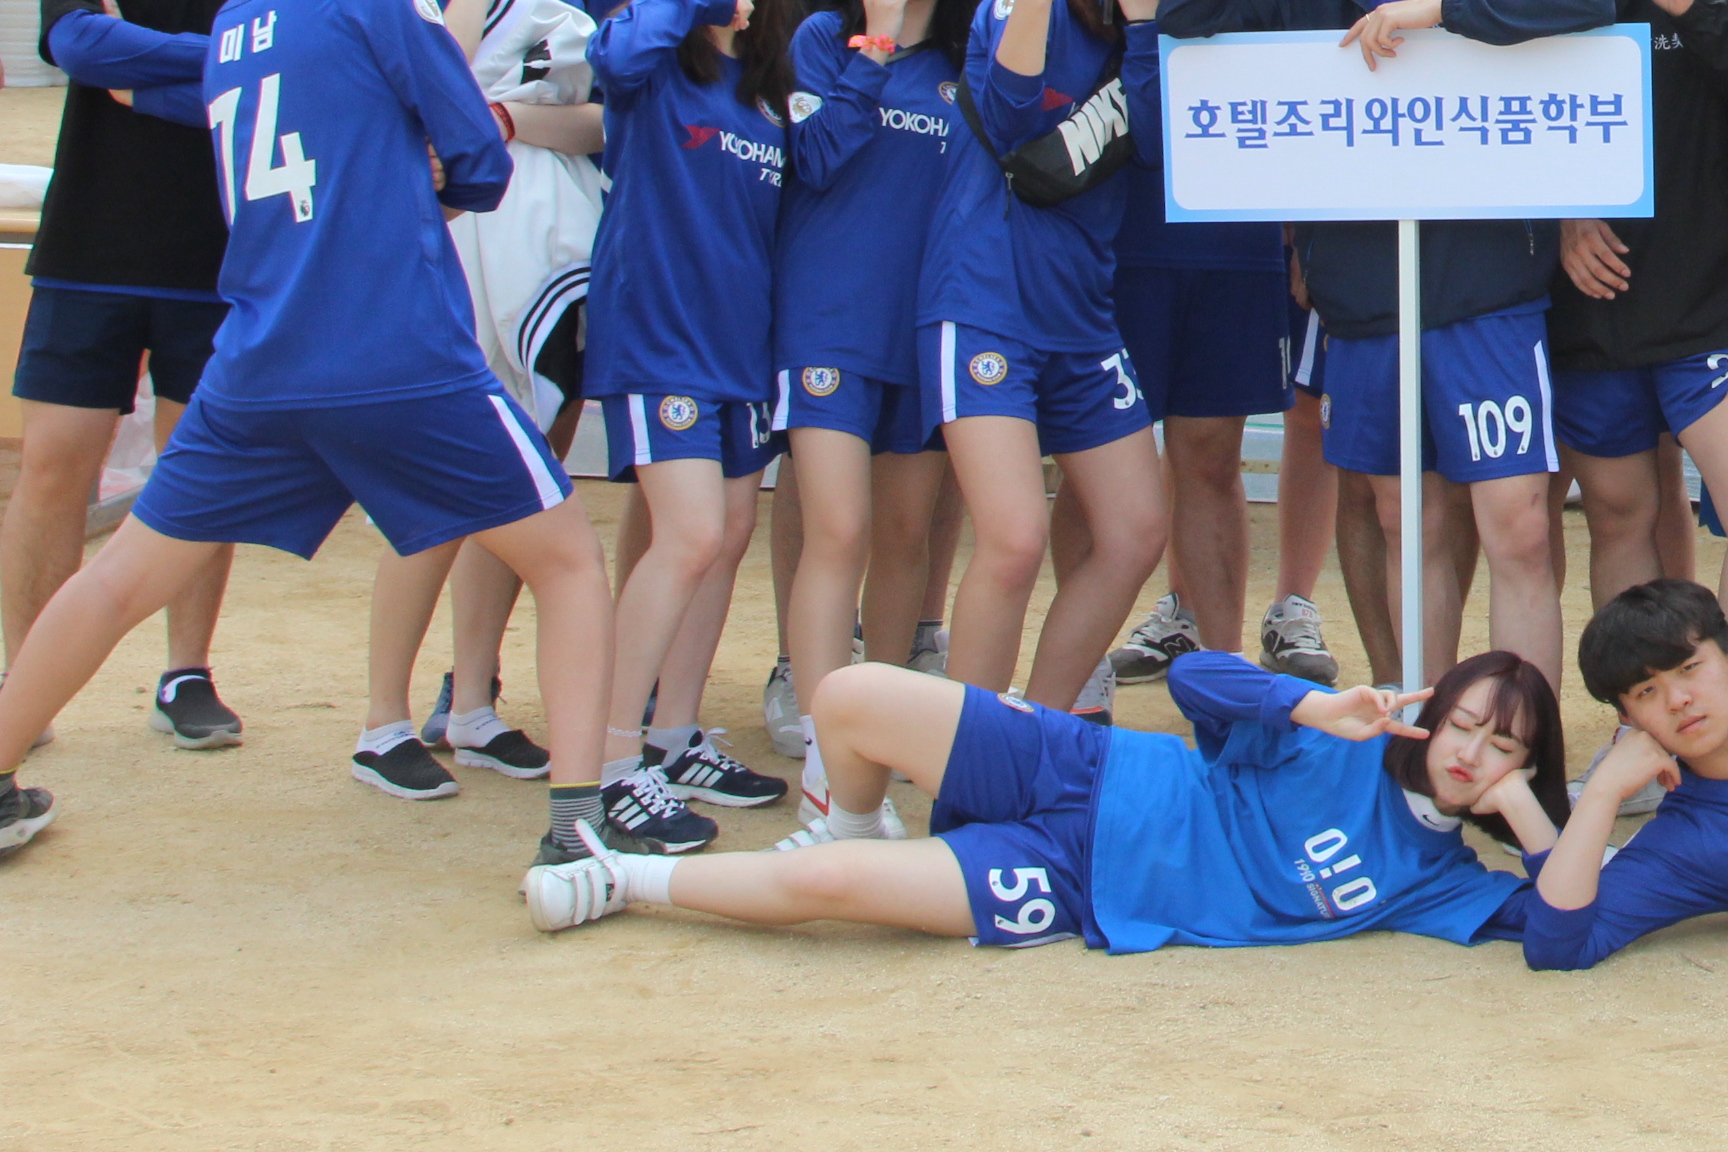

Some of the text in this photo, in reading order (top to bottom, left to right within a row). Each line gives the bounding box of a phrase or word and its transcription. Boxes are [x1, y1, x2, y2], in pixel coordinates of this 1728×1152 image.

[1184, 92, 1629, 149] 호텔조리와인식품학부
[1458, 395, 1533, 462] 109
[988, 867, 1056, 935] 59
